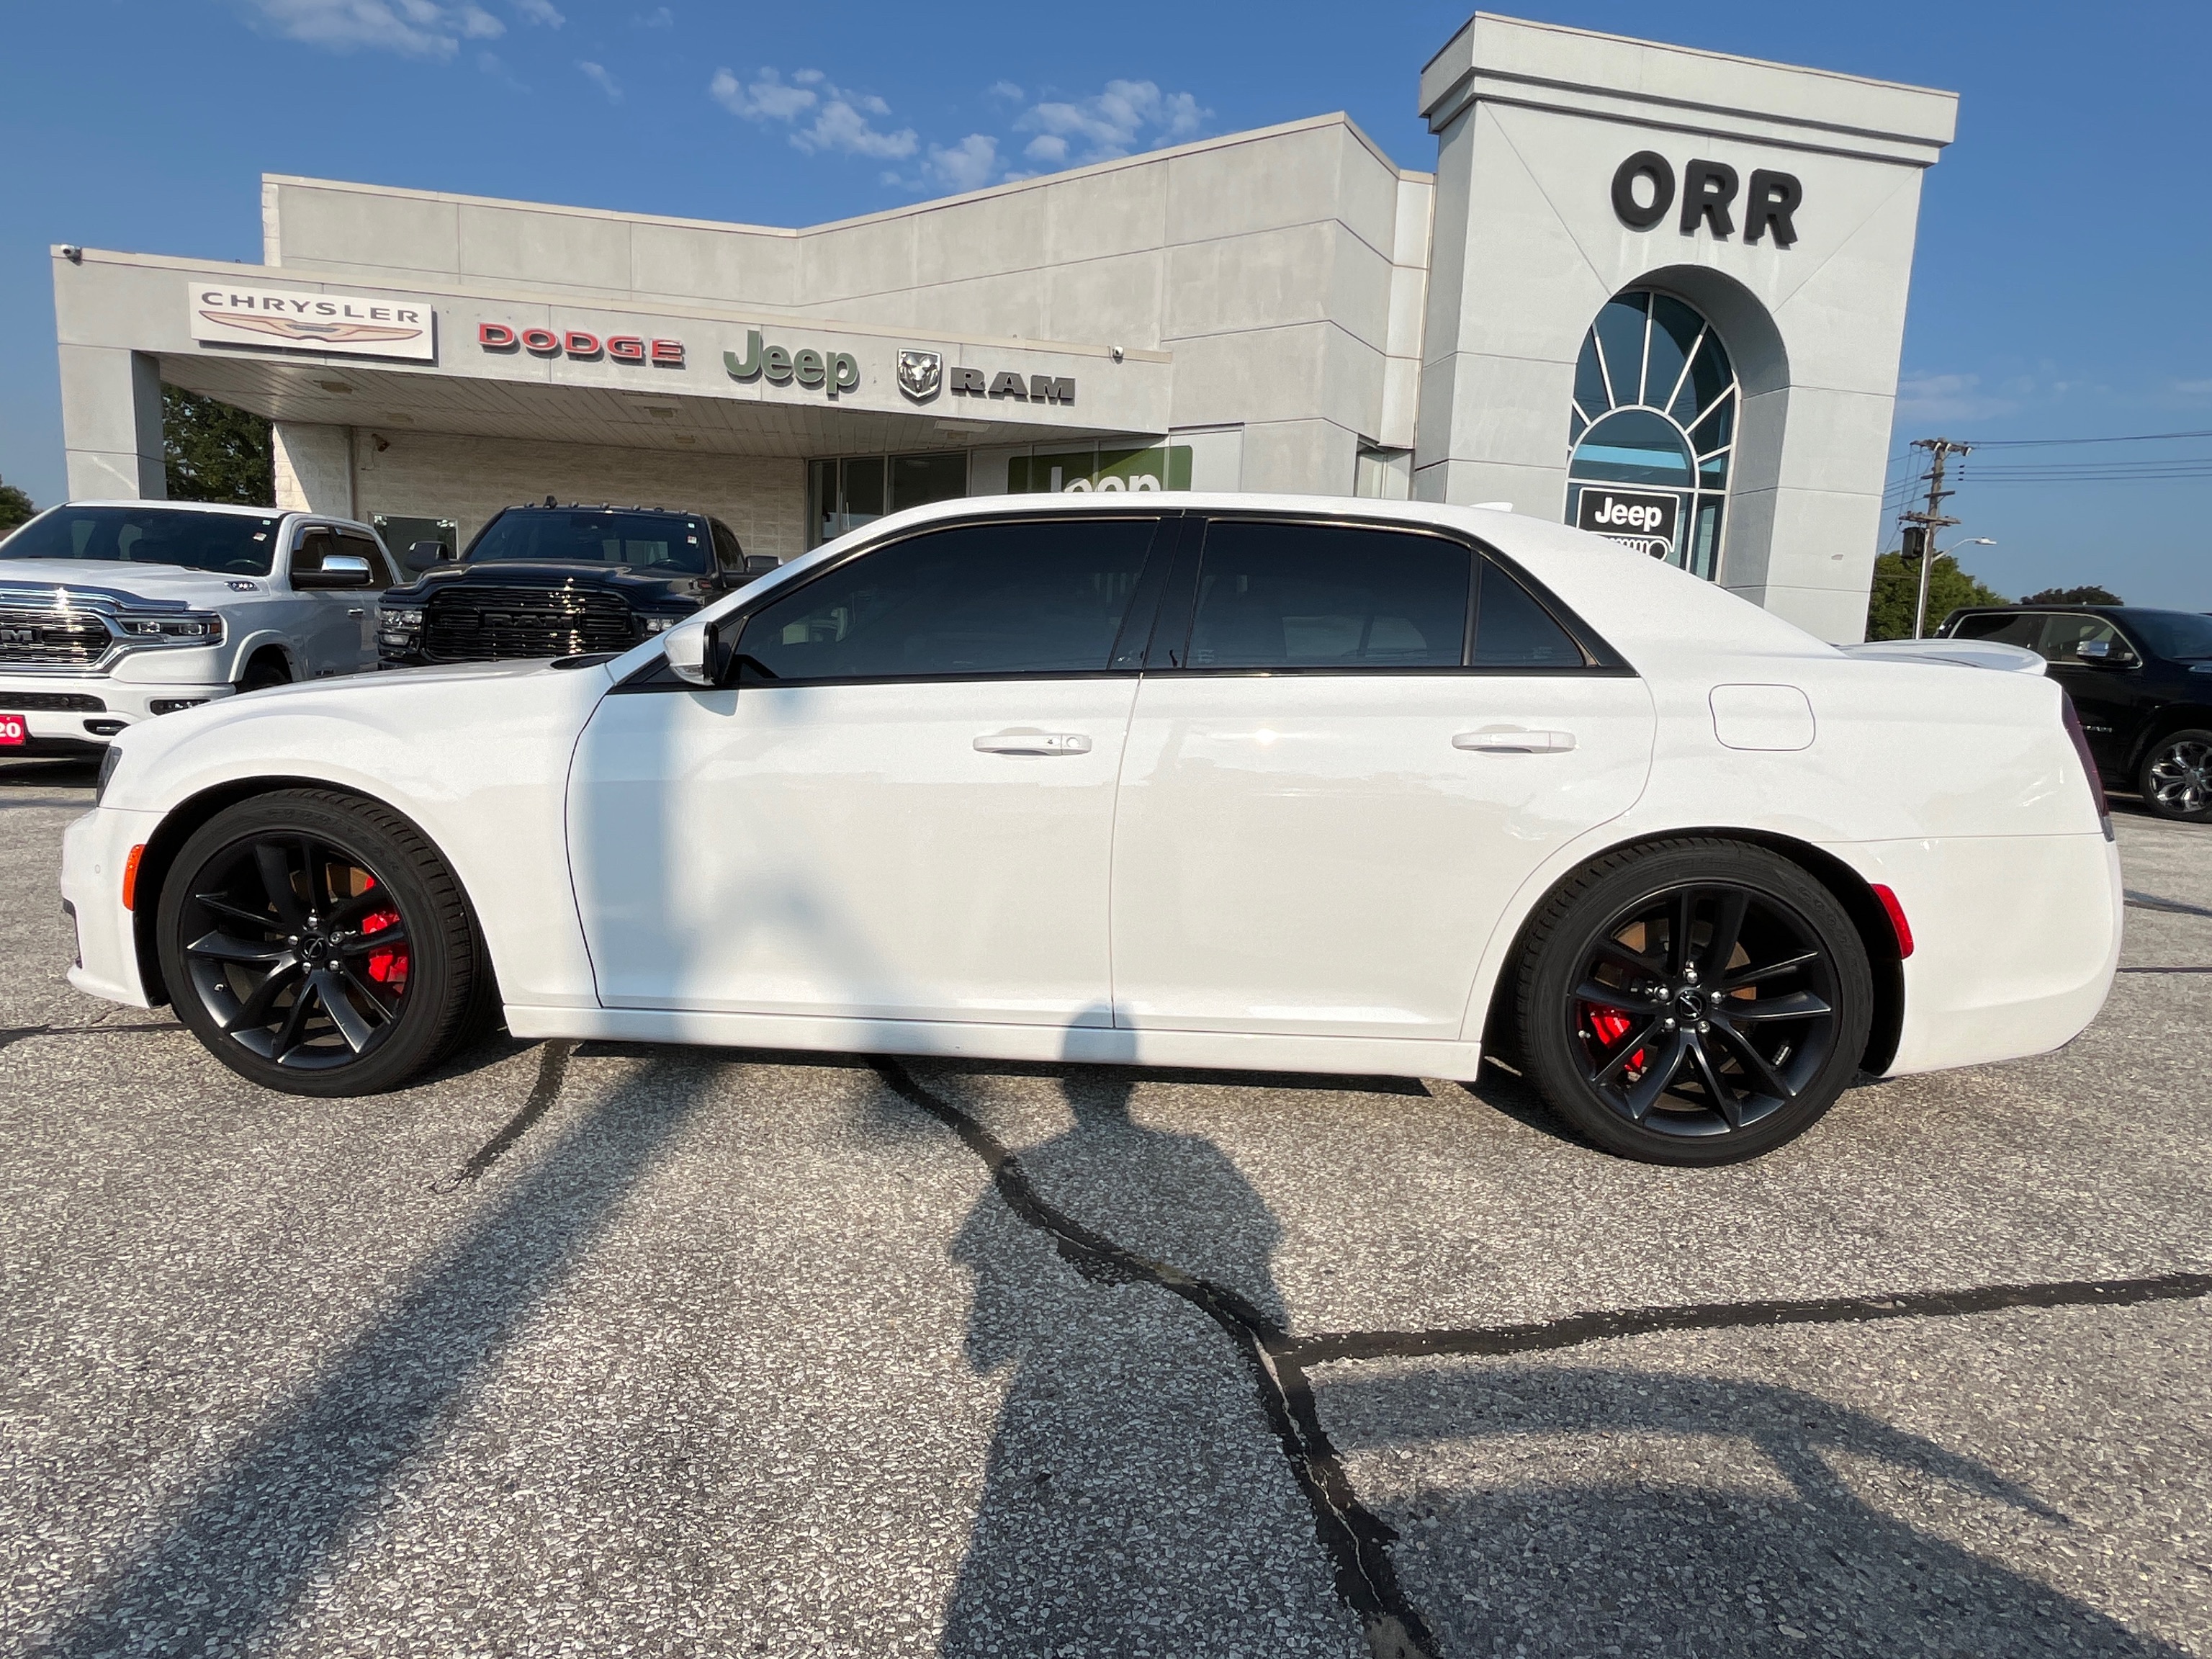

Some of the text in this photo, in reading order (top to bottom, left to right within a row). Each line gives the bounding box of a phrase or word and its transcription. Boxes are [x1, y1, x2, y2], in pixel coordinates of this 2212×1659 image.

[1611, 150, 1802, 249] ORR
[201, 291, 419, 323] CHRYSLER
[478, 322, 683, 363] DODGE
[723, 329, 858, 395] Jeep
[950, 367, 1076, 400] RAM
[1594, 497, 1663, 532] Jeep
[485, 613, 574, 627] RAM
